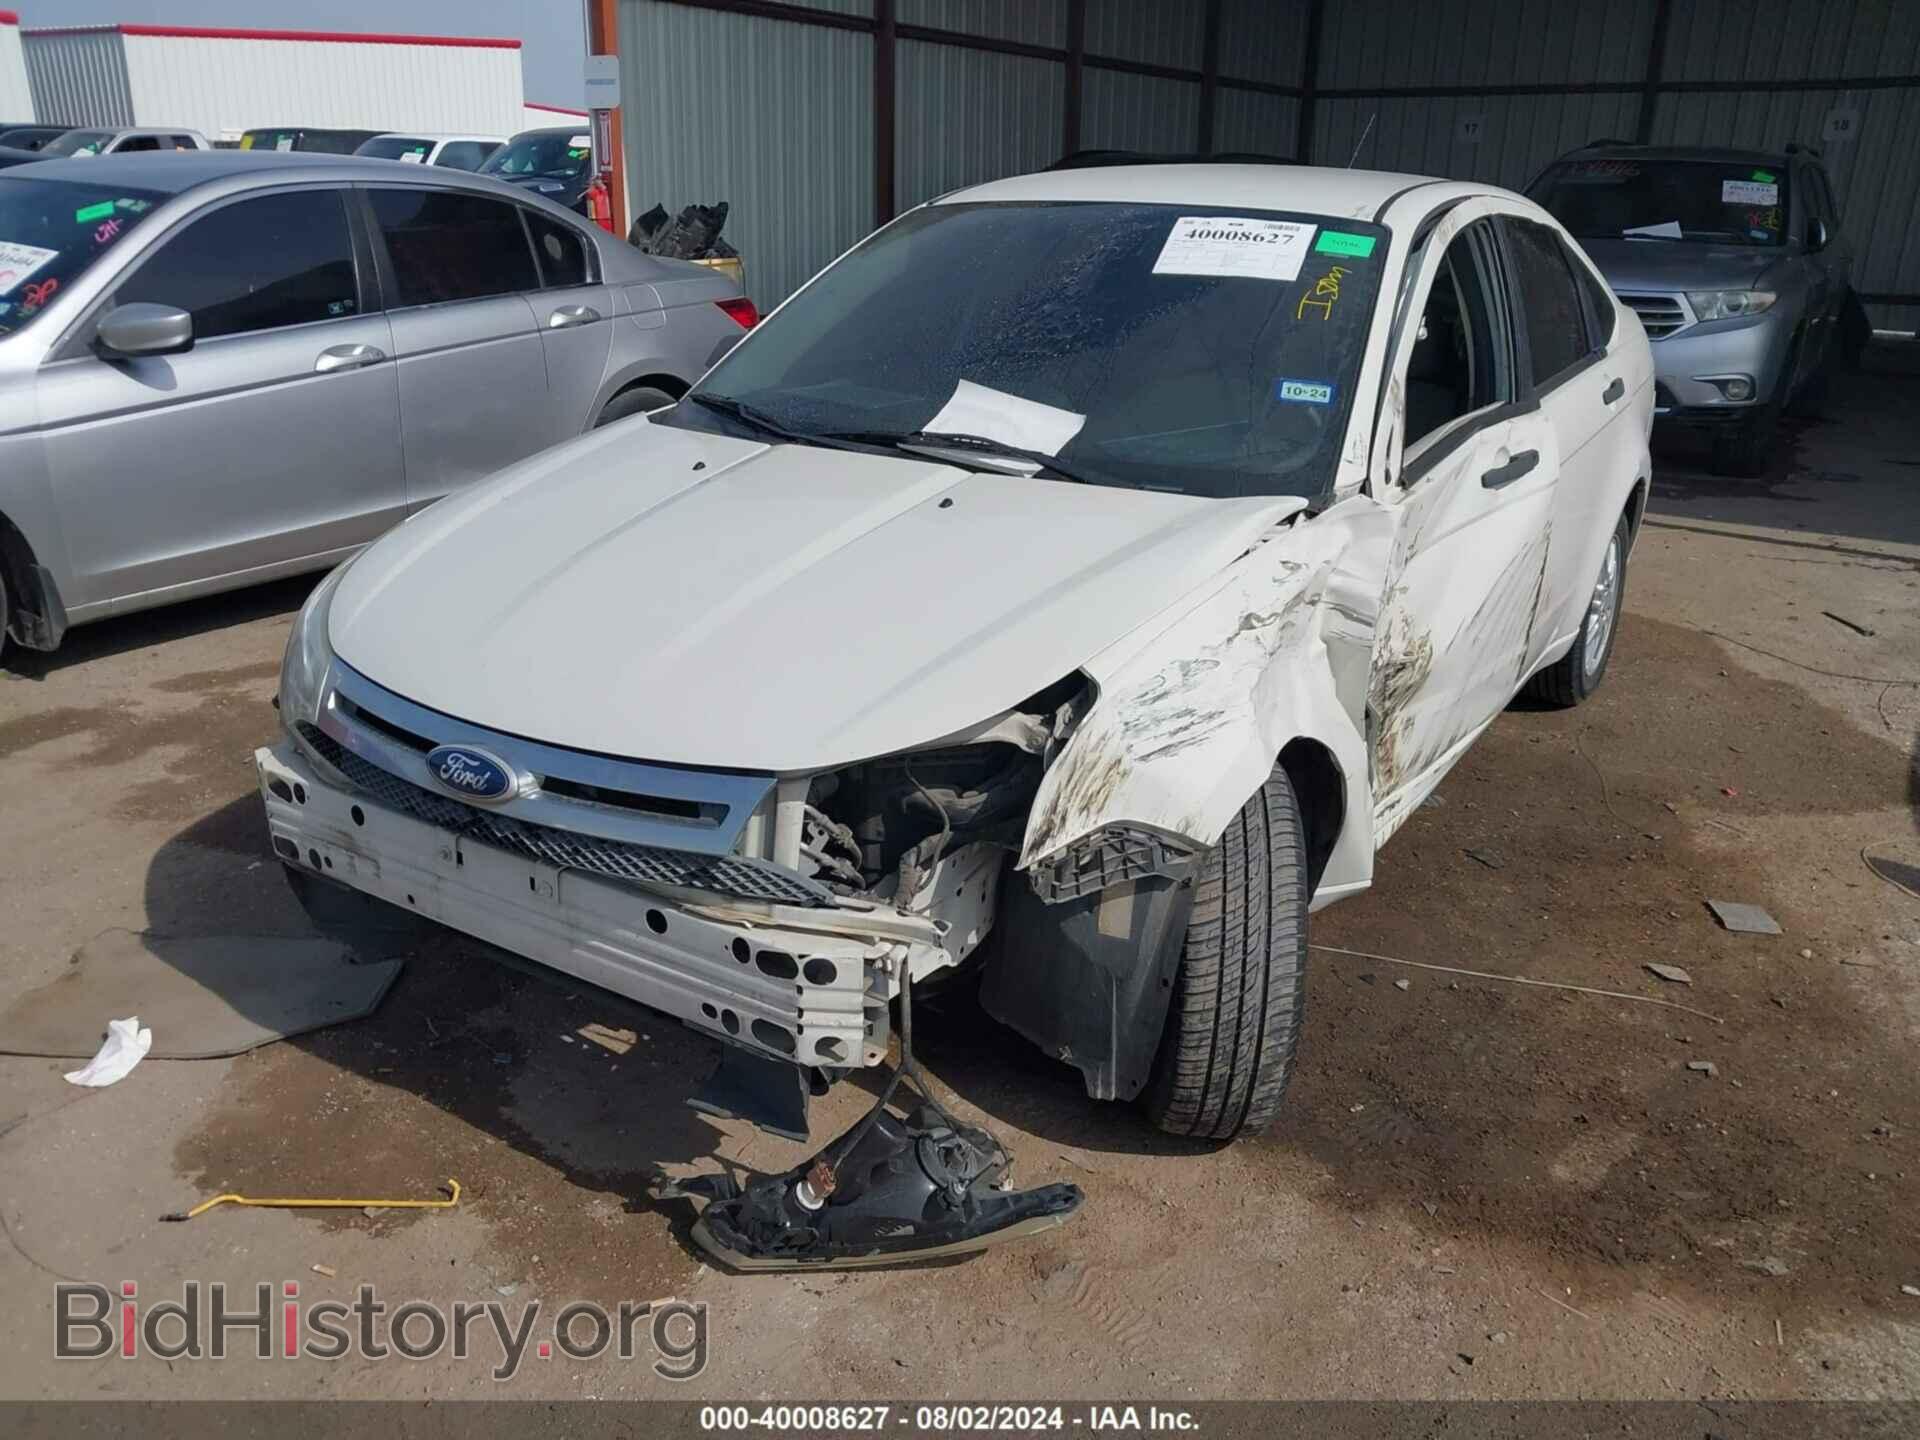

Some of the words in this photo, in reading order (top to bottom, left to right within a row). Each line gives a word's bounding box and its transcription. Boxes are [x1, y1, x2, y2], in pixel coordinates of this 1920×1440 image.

[1463, 119, 1479, 134] 17
[1184, 230, 1295, 245] 40008627
[440, 752, 491, 790] Ford
